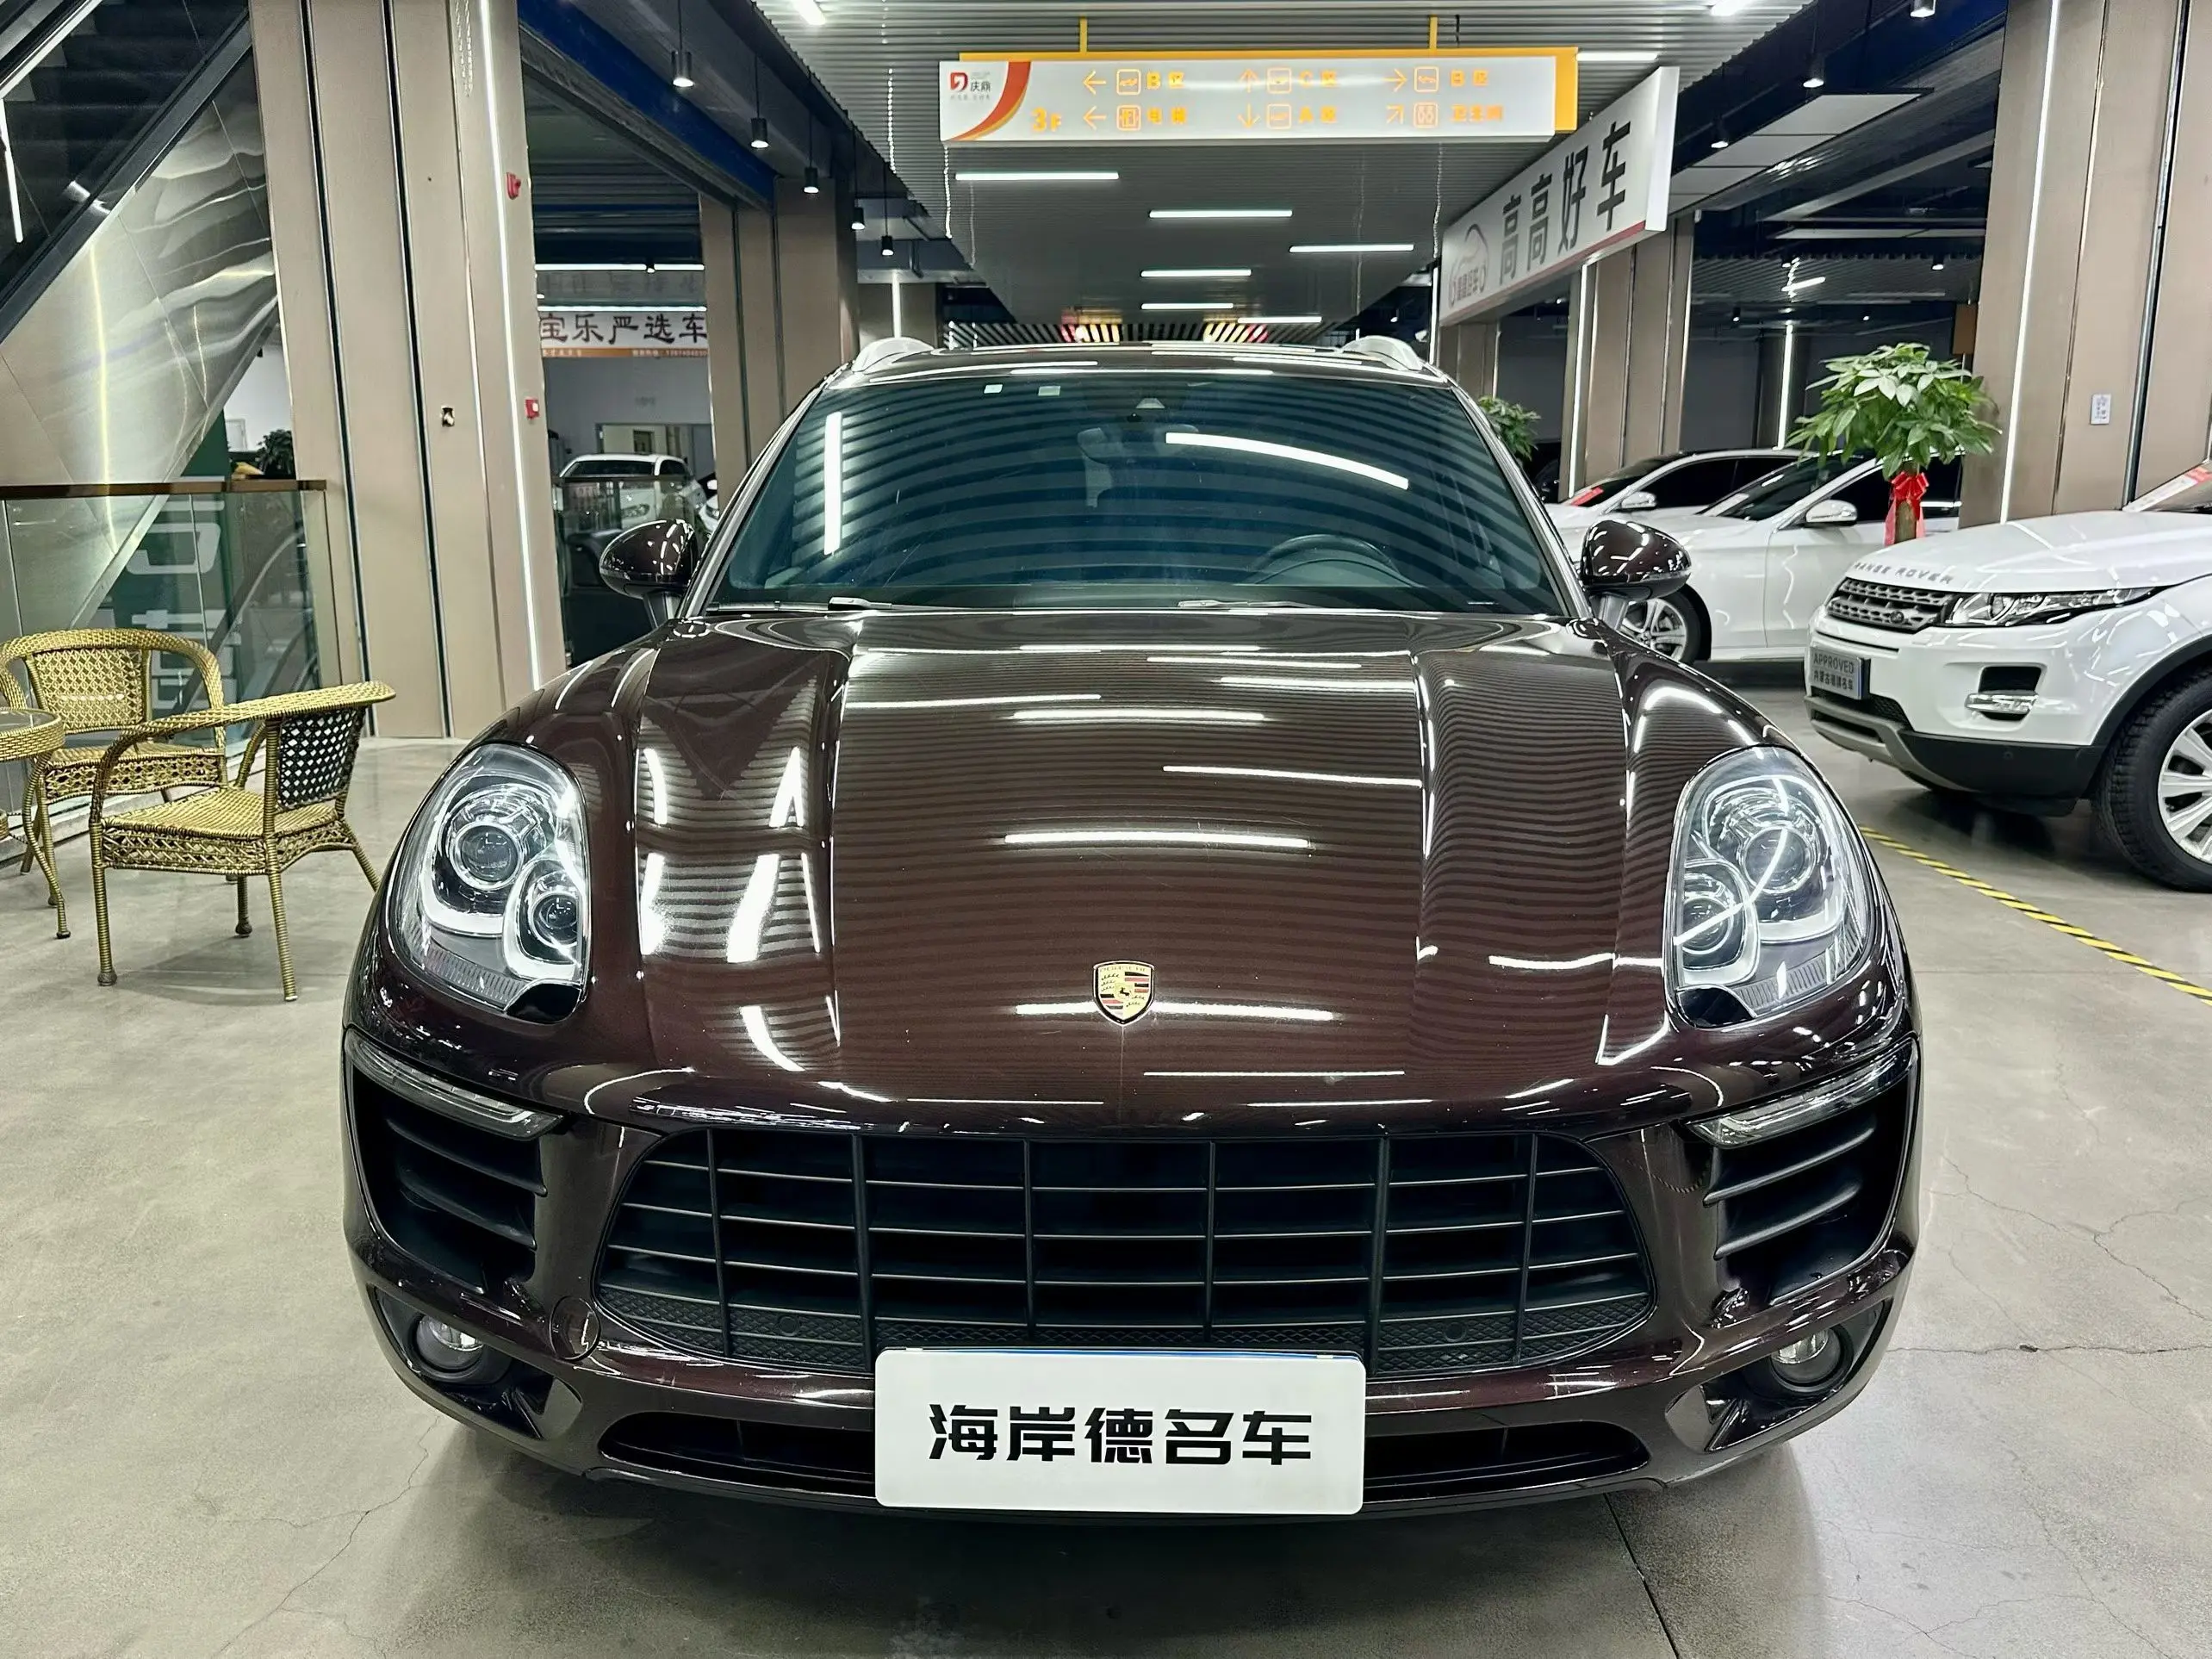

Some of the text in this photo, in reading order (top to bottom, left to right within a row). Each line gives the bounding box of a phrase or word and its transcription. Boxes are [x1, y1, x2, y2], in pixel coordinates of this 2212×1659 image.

[1032, 107, 1062, 132] 3F
[1500, 121, 1631, 285] 高高好车
[539, 313, 707, 345] 宝乐严选车
[1813, 653, 1855, 674] APPROVED
[929, 1403, 1313, 1465] 海岸德名车
